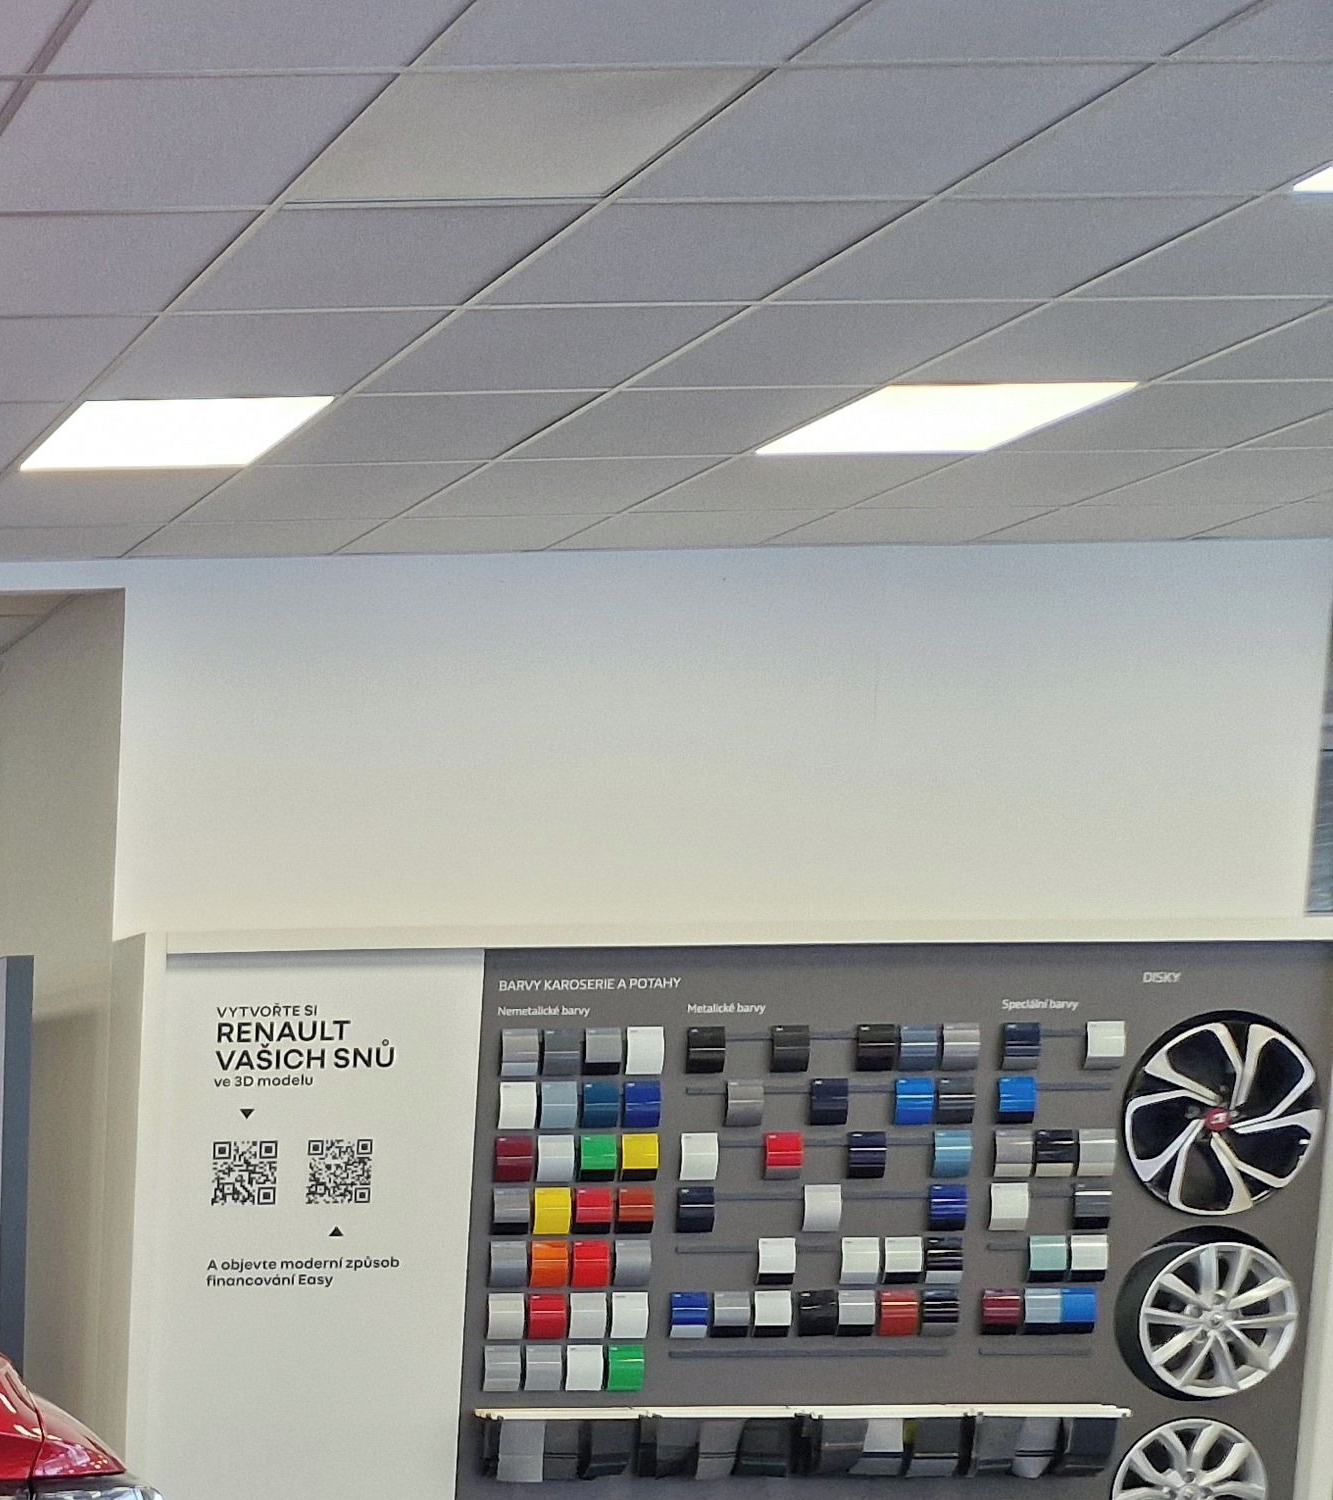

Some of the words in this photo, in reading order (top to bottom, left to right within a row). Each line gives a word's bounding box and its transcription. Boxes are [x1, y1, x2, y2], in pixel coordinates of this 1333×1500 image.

[498, 979, 541, 992] BARVY
[544, 978, 614, 991] KAROSERIE
[617, 977, 627, 990] A
[629, 977, 681, 989] POTAHY
[1142, 972, 1181, 983] DISKY
[217, 1003, 301, 1018] VYTVOŘTE
[304, 1004, 318, 1017] SI
[497, 1004, 559, 1017] Nemetalické
[561, 1005, 590, 1018] barvy
[687, 1003, 734, 1014] Metalické
[737, 1003, 766, 1015] barvy
[1049, 1000, 1079, 1011] barvy
[217, 1020, 351, 1043] RENAULT
[215, 1044, 326, 1070] VAŠICH
[333, 1039, 396, 1069] SNŮ
[214, 1078, 230, 1087] ve
[234, 1076, 254, 1087] 3D
[257, 1074, 314, 1087] modelu
[207, 1260, 218, 1271] A
[221, 1259, 277, 1273] objevte
[280, 1257, 343, 1270] moderní
[345, 1256, 400, 1272] způsob
[206, 1274, 295, 1287] financování
[298, 1275, 333, 1288] Easy
